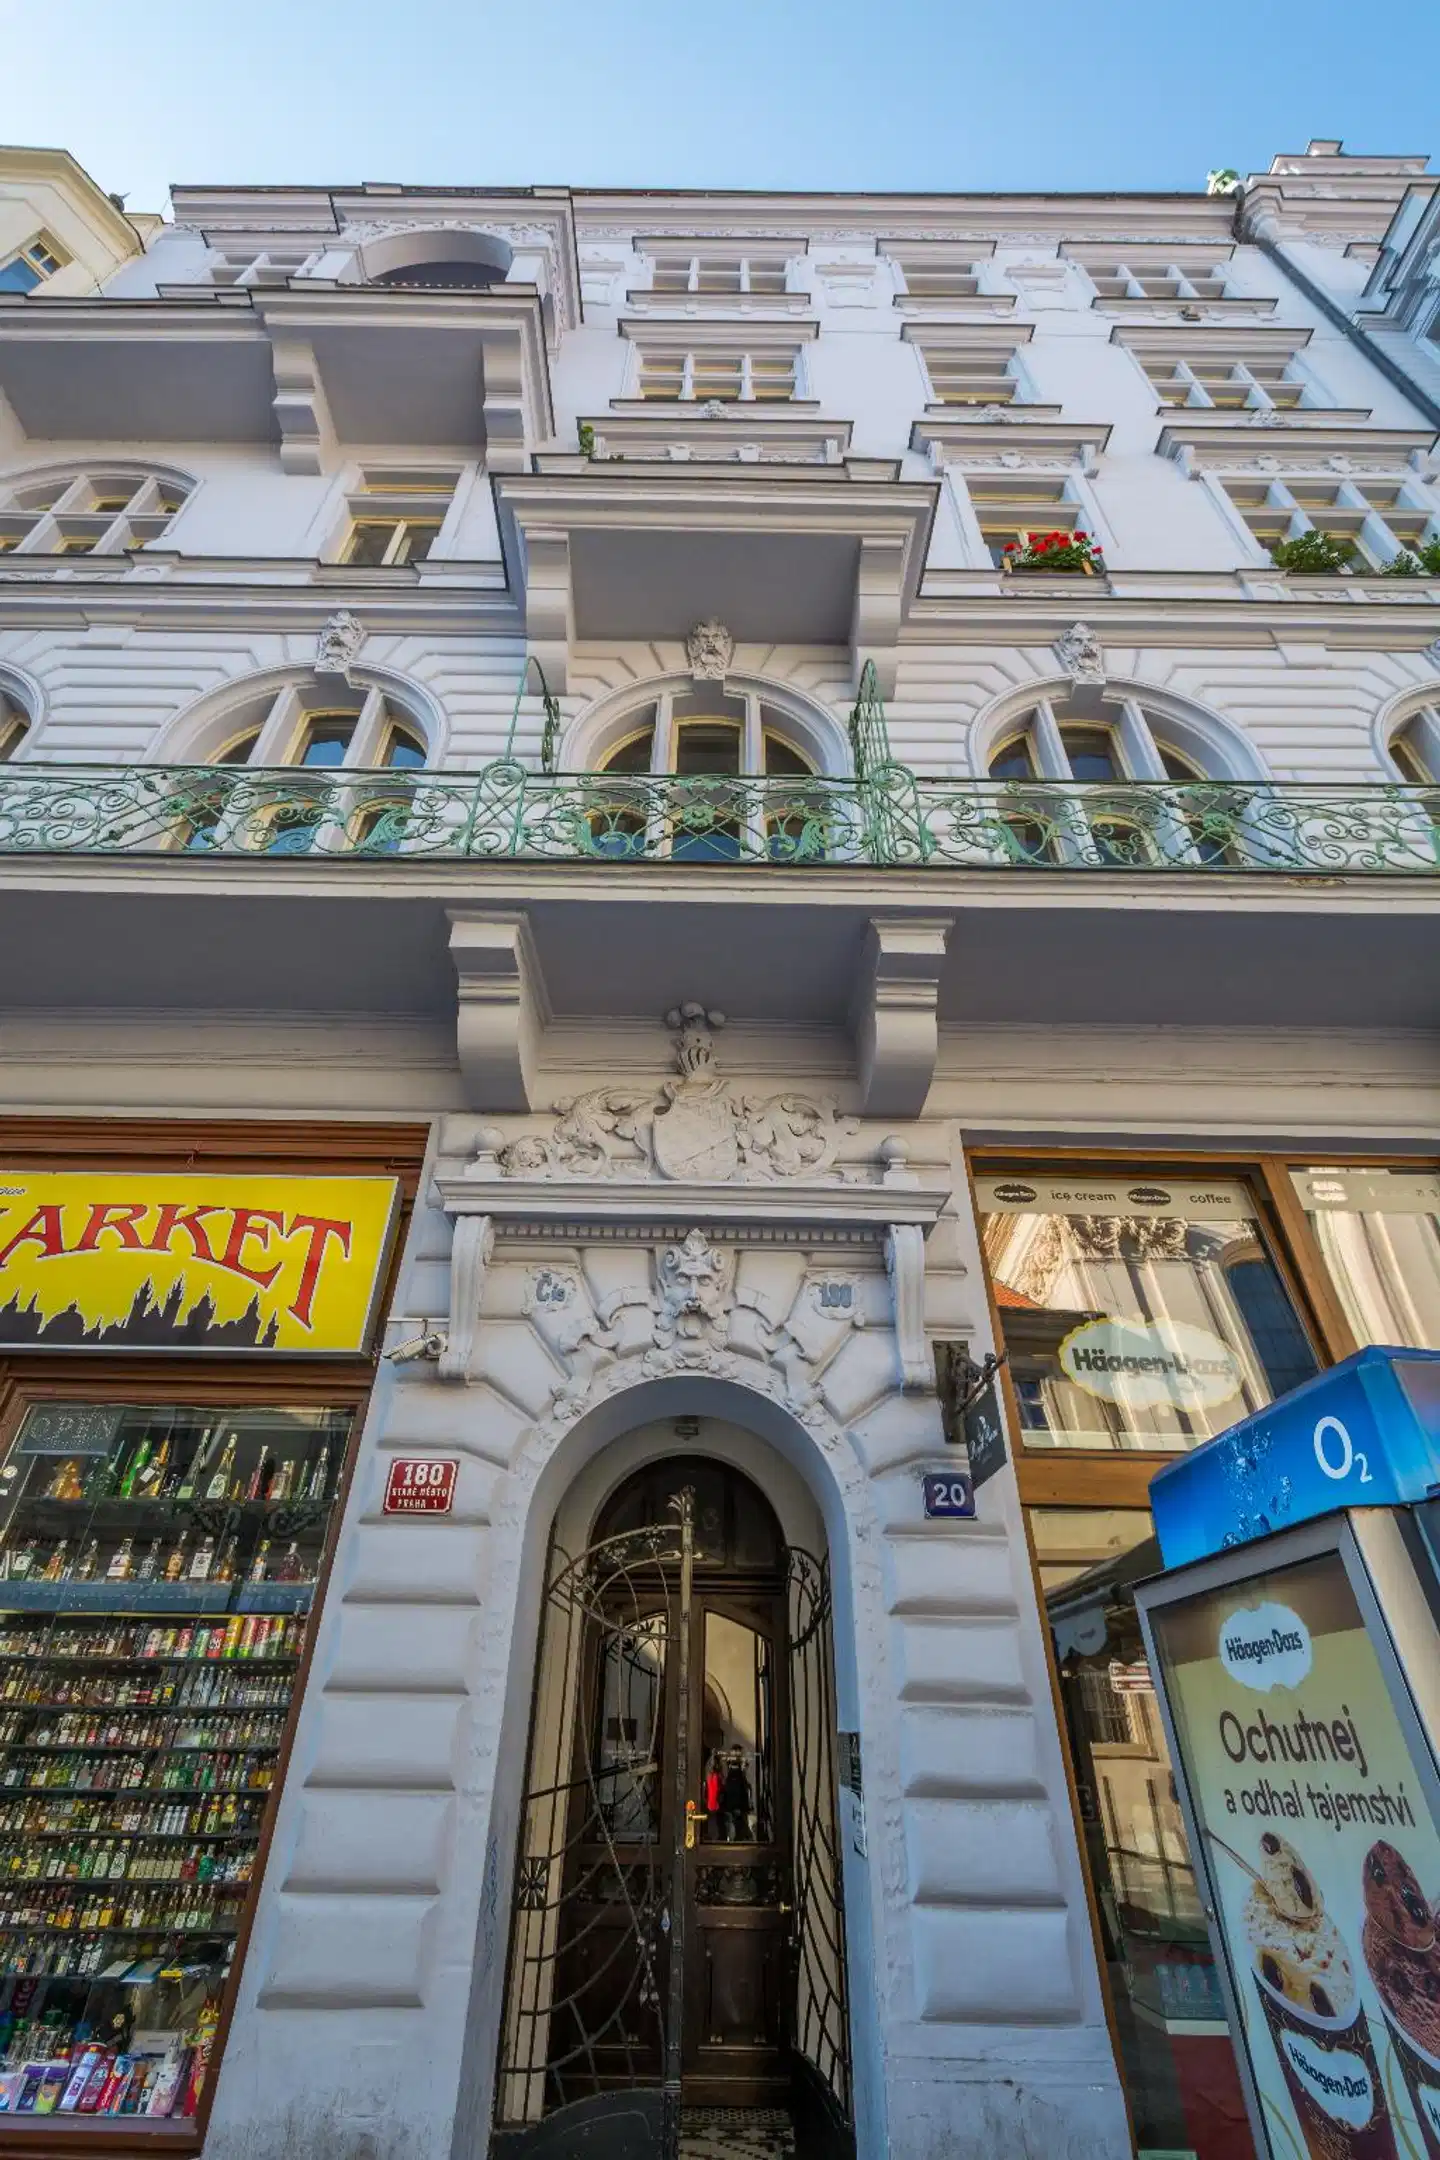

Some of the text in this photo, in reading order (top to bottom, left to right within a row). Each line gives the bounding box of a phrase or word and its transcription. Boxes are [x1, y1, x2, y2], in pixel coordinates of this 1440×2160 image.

[1050, 1190, 1116, 1201] ice cream
[1189, 1193, 1232, 1204] coffee
[0, 1203, 352, 1330] ARKET
[403, 1464, 444, 1486] 180
[397, 1498, 438, 1508] PRAHA 1
[933, 1483, 966, 1506] 20
[1225, 1629, 1304, 1664] Häagen-Dazs
[1219, 1704, 1368, 1778] Ochutnej
[1224, 1778, 1416, 1832] a odhal tajemství
